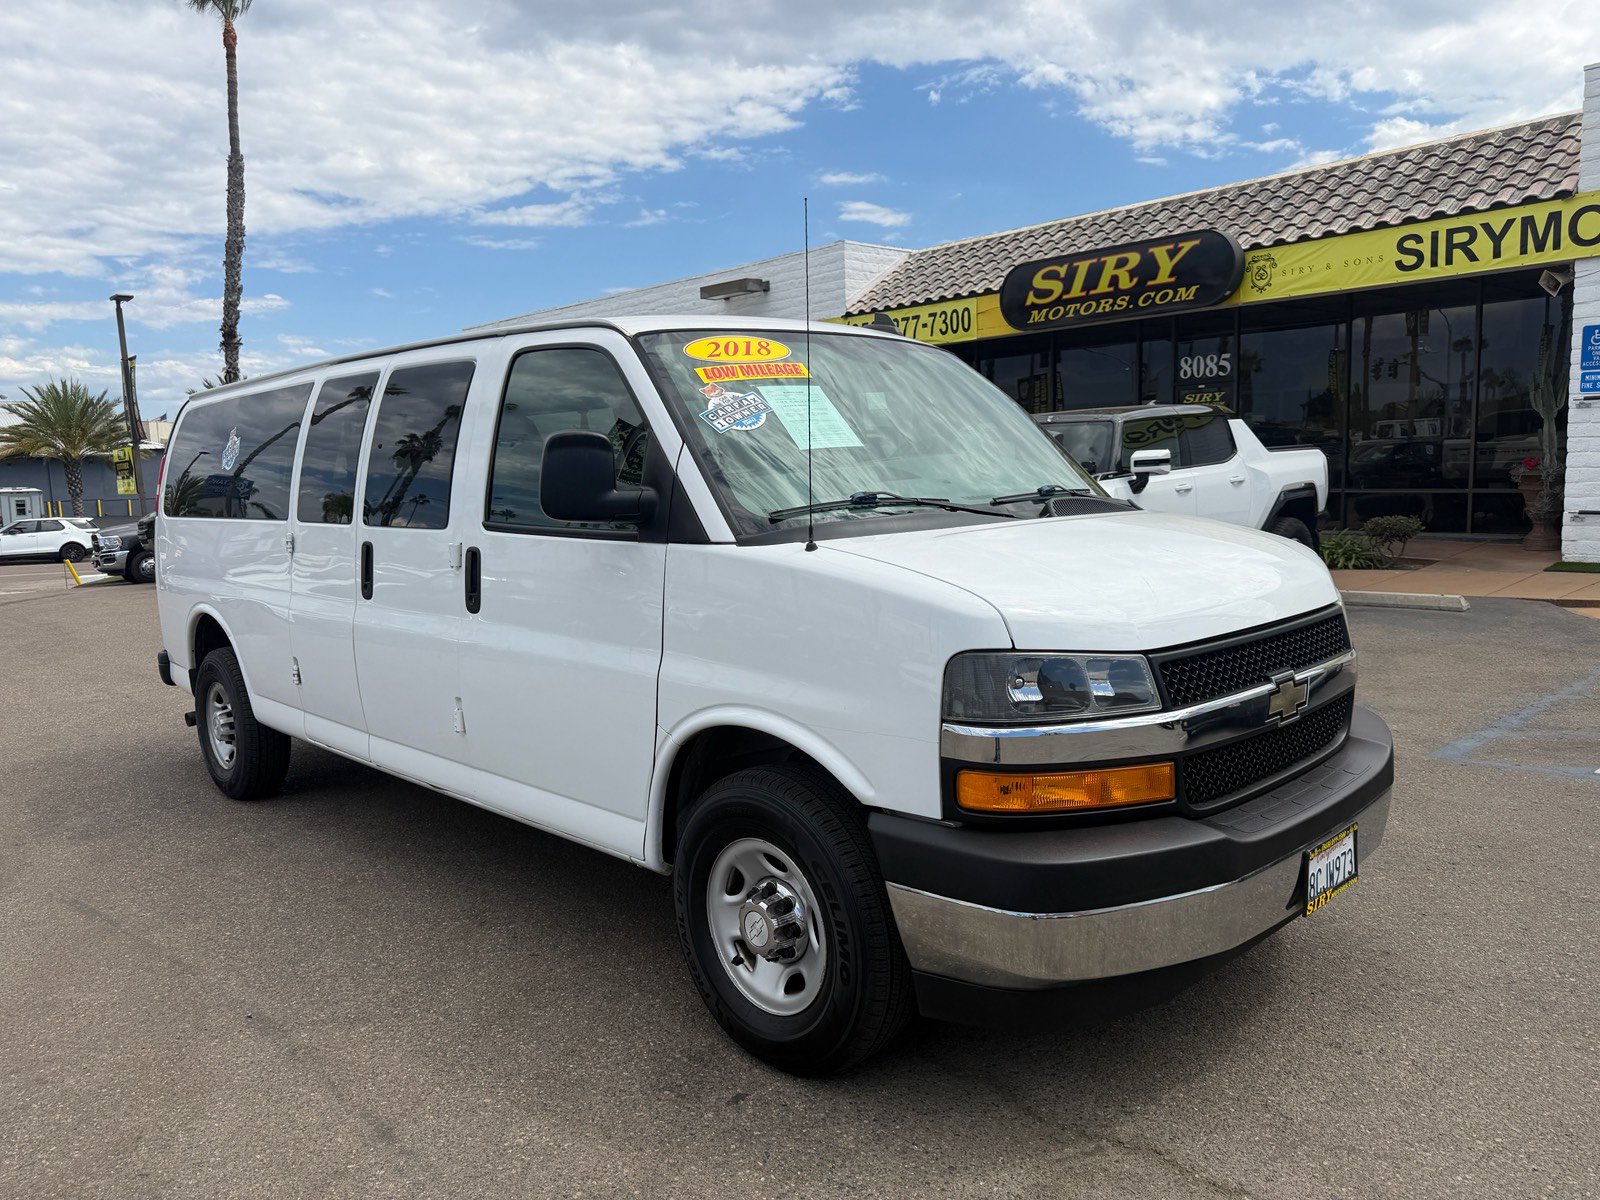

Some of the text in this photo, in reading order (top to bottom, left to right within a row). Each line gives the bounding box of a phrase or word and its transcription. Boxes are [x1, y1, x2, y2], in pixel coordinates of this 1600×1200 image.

[1394, 204, 1600, 272] SIRYMO
[1025, 238, 1201, 307] SIRY
[1281, 254, 1385, 277] SIRY & SONS
[1026, 284, 1200, 324] MOTORS.COM
[893, 307, 972, 339] 77-7300
[706, 340, 772, 358] 2018
[702, 363, 806, 381] LOW MILEAGE
[1179, 353, 1232, 380] 8085
[707, 397, 760, 421] CARFAX
[1183, 391, 1226, 404] SIRY
[716, 421, 726, 429] 1
[724, 403, 768, 425] OWNER
[1308, 847, 1354, 900] 8CJW973
[1306, 887, 1335, 917] SIRY
[811, 860, 852, 985] CELIMO
